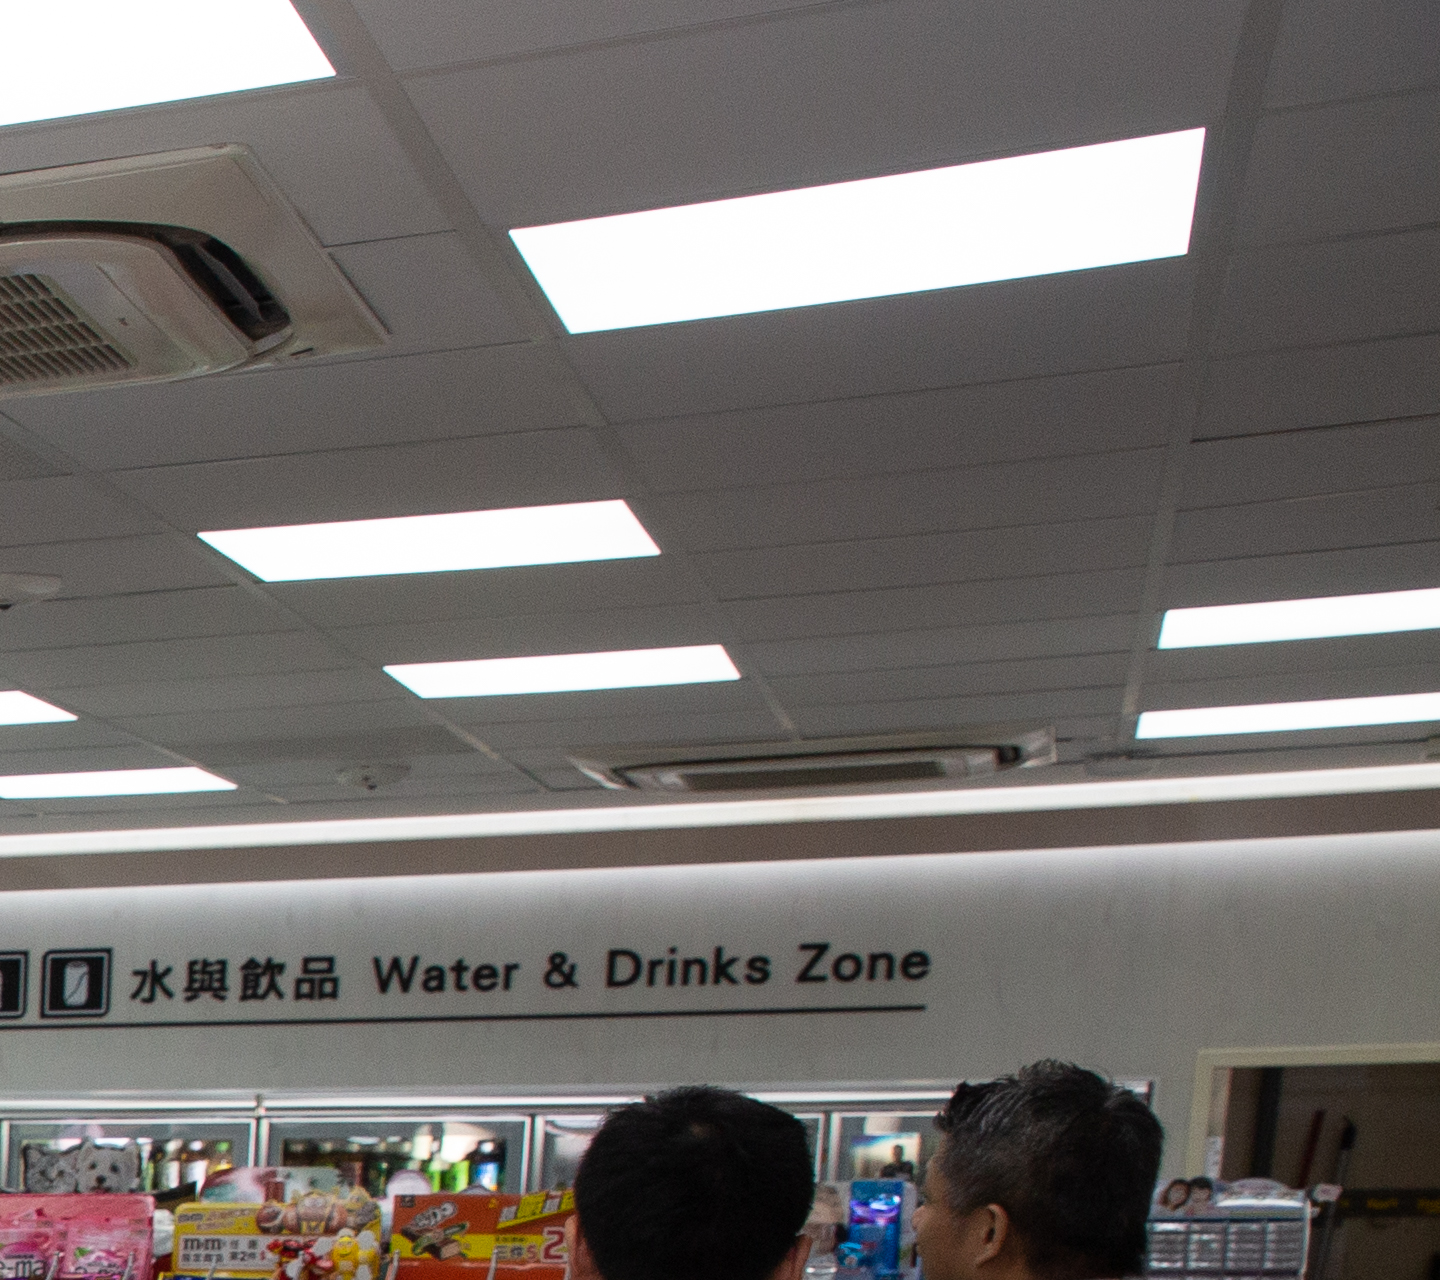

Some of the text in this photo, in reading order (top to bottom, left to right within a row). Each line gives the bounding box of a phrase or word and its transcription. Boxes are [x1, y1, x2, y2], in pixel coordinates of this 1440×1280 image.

[130, 942, 931, 1004] 水與飲品 Water & Drinks Zone
